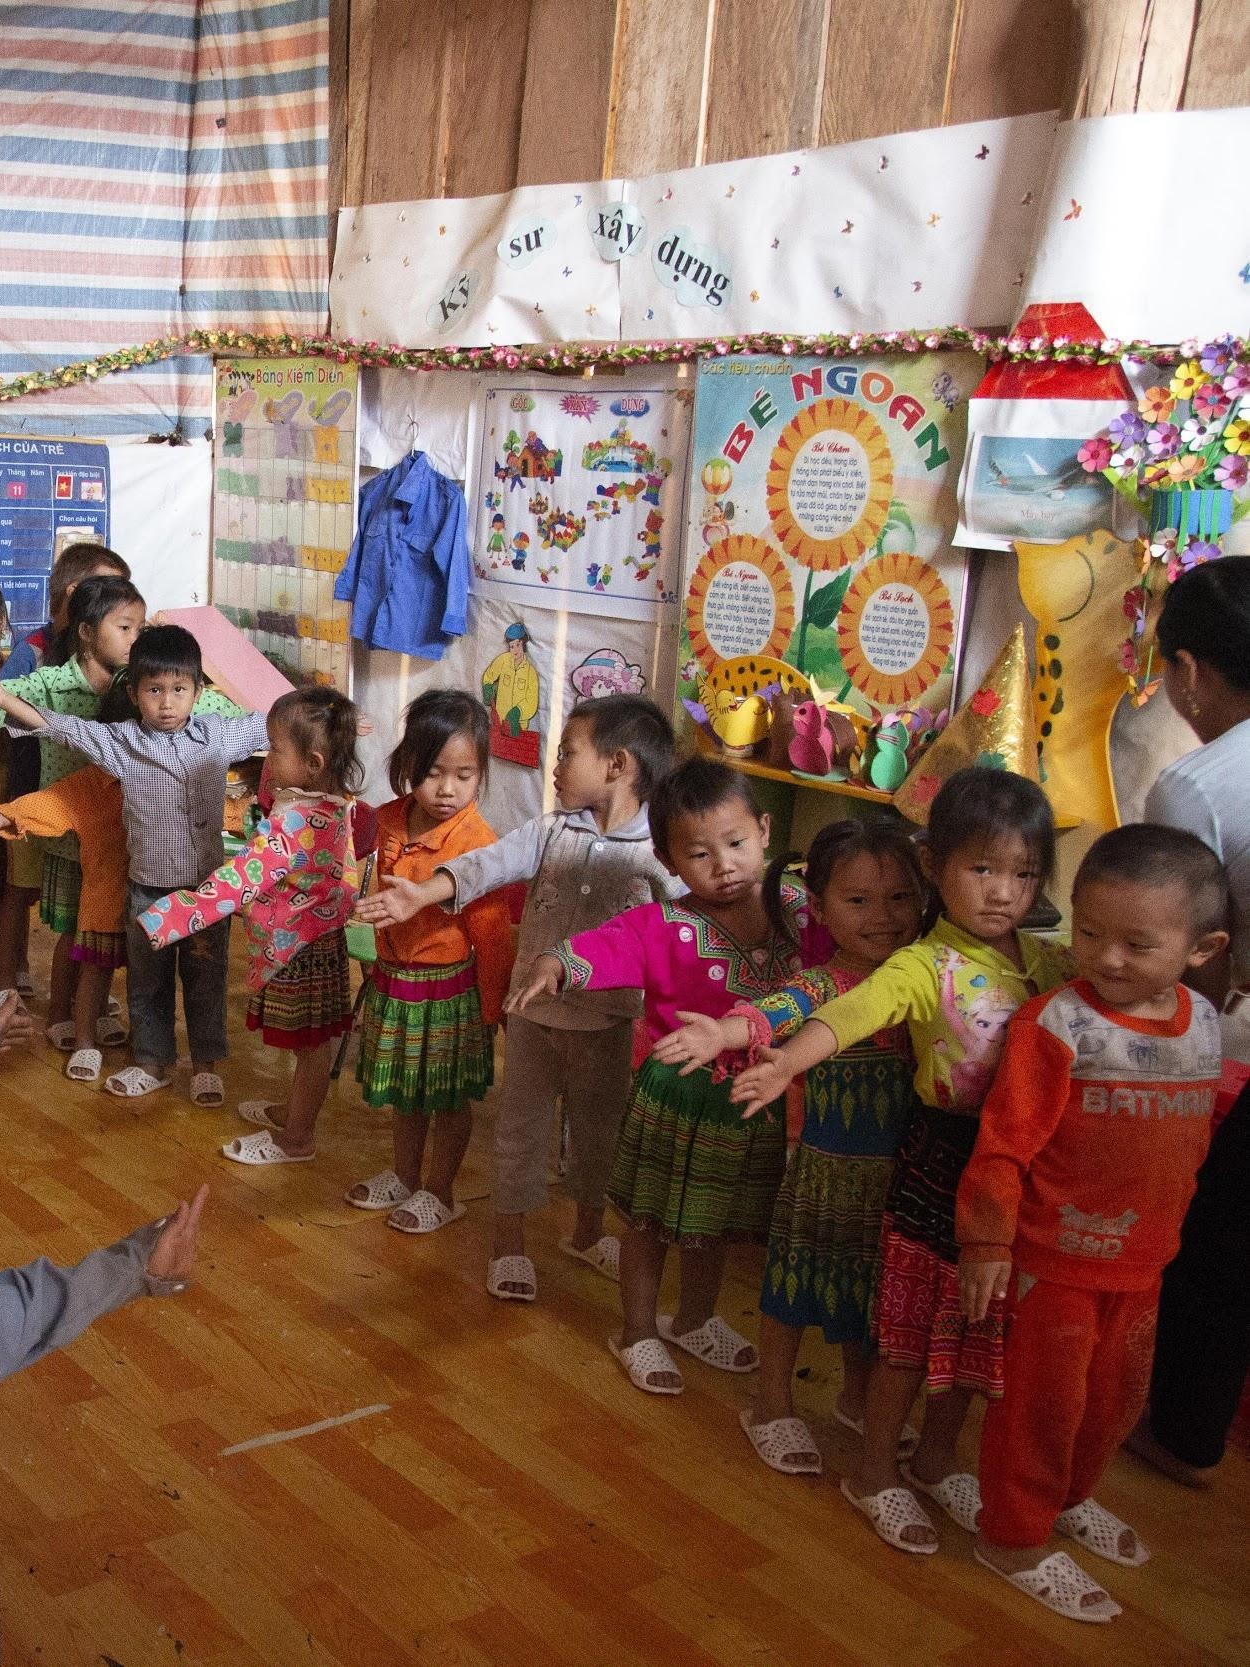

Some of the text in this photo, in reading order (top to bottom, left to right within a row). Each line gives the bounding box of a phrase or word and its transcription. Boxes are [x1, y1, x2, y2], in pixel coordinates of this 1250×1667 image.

[438, 209, 730, 321] Kỹ sư xây dựng
[256, 365, 284, 388] Bảng
[287, 363, 314, 384] Kiểm
[722, 365, 951, 472] BÉ NGOAN
[13, 441, 39, 454] CỦA
[40, 443, 65, 455] TRẺ
[13, 486, 22, 495] 11
